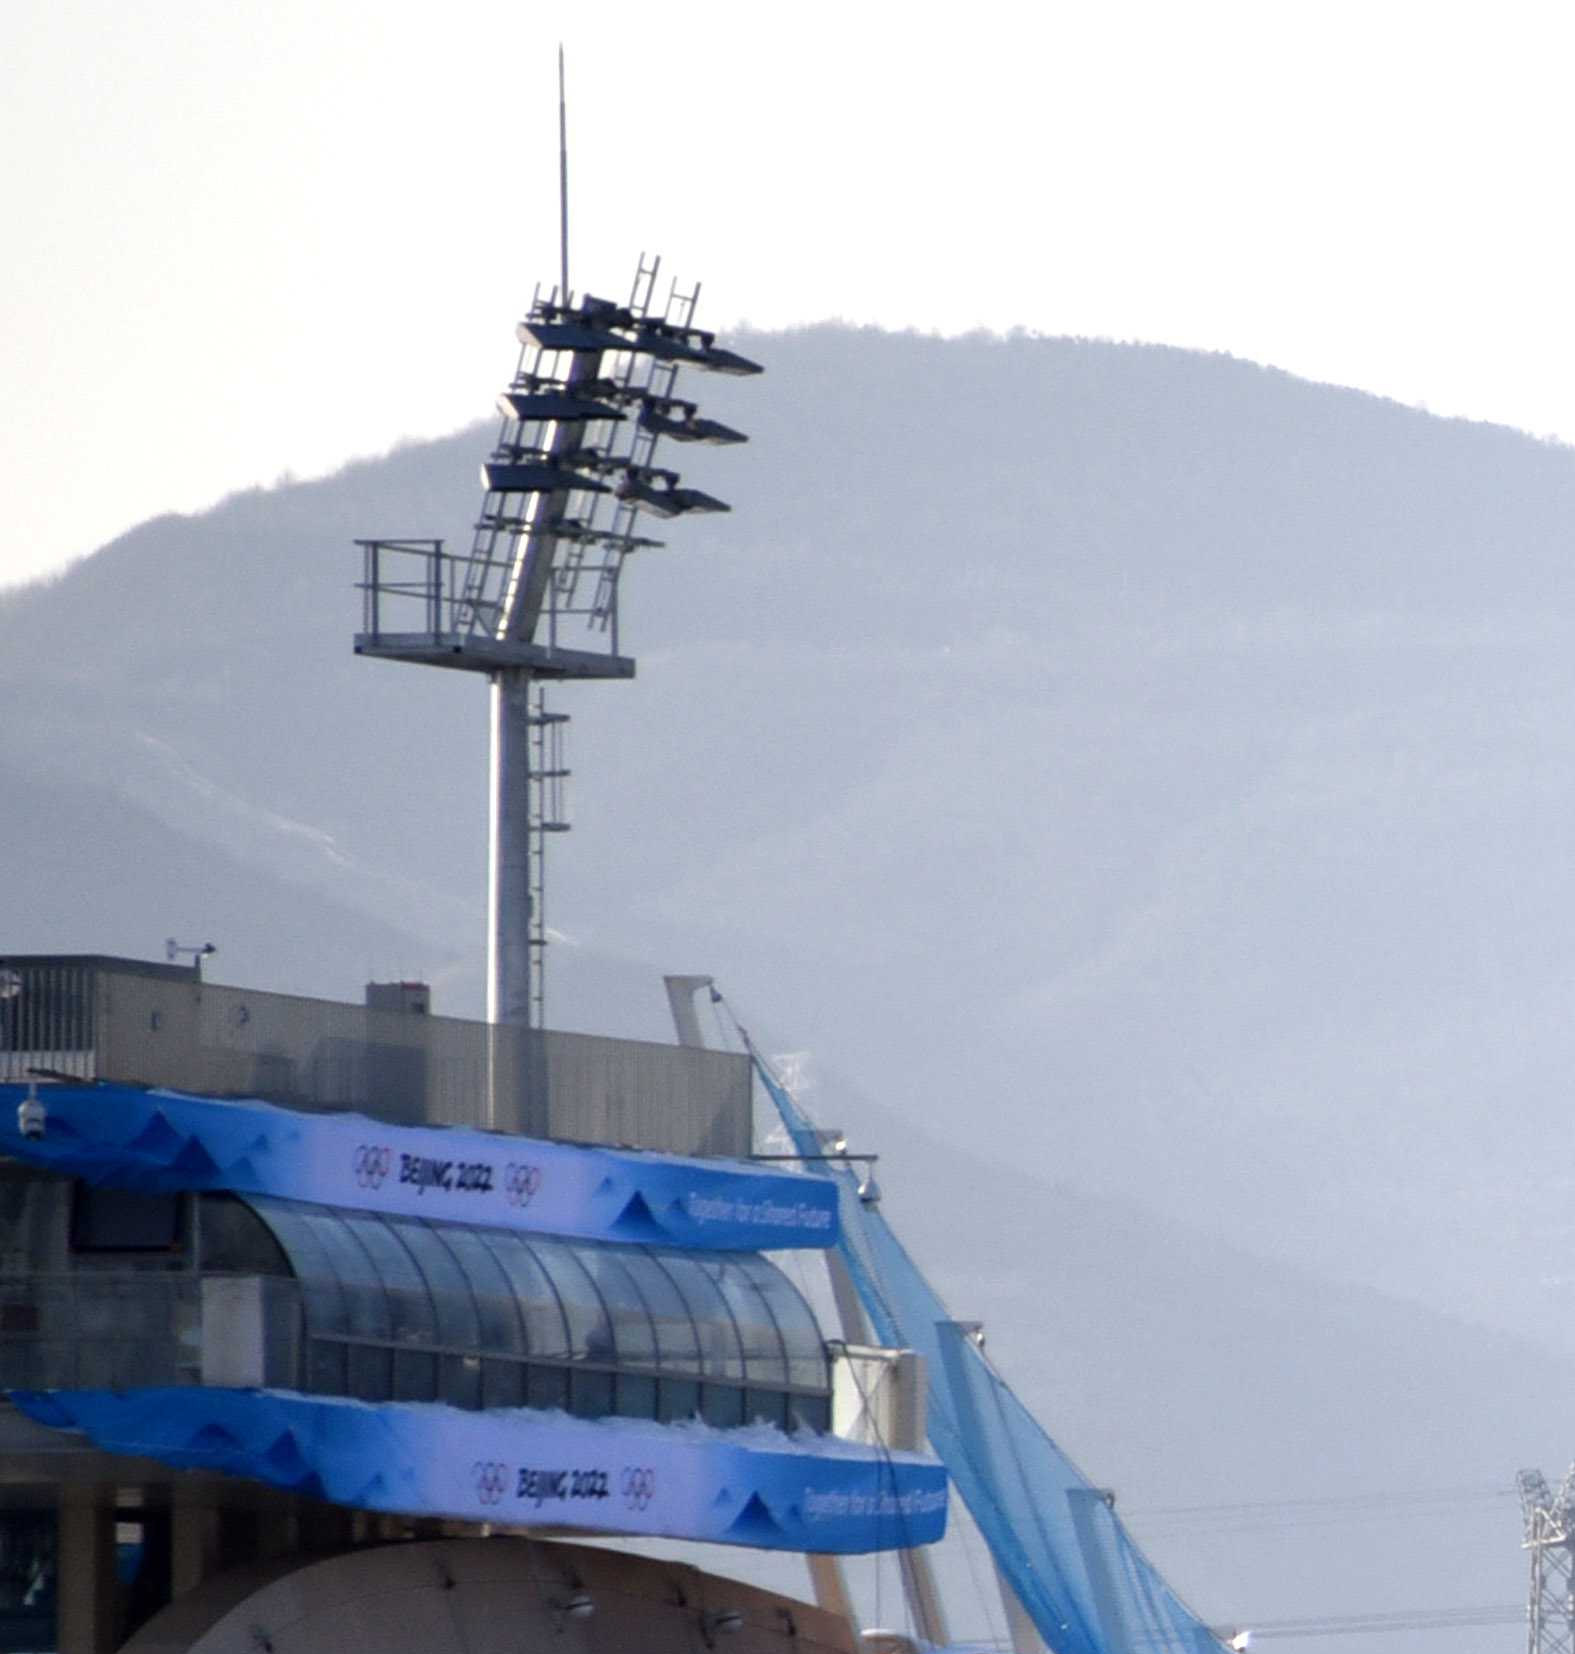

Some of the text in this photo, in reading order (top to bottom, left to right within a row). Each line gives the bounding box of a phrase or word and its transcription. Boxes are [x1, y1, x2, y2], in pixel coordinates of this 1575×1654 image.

[399, 1153, 495, 1195] BEIJING 2022
[516, 1466, 611, 1508] BEIJING 2022
